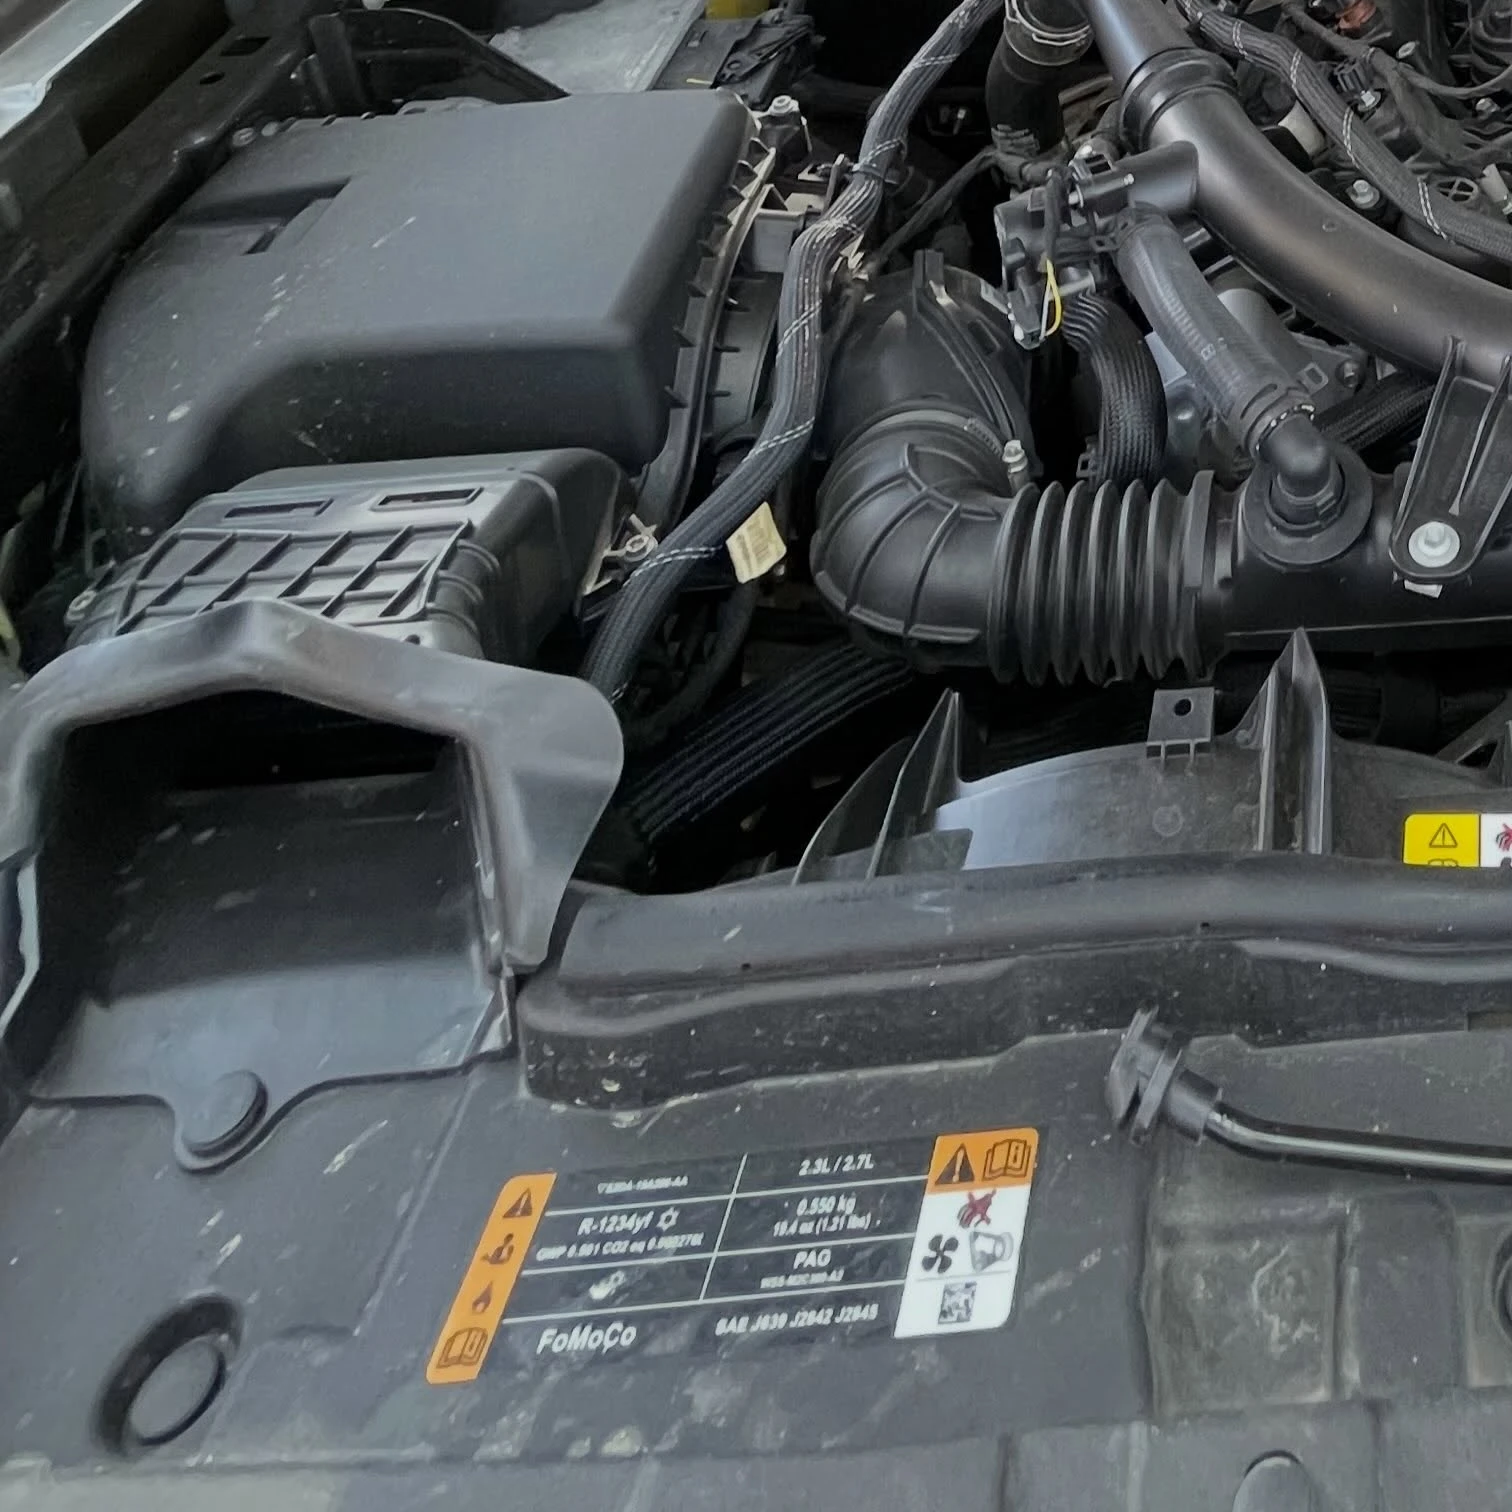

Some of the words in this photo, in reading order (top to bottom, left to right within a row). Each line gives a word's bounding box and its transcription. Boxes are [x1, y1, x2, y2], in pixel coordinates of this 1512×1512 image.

[842, 1153, 874, 1172] 2.7L
[796, 1197, 836, 1216] 0.550
[837, 1192, 857, 1215] kg
[577, 1211, 654, 1235] R-1234yf
[602, 1239, 630, 1255] CO2
[793, 1249, 831, 1270] PAG
[715, 1316, 749, 1336] SAE
[536, 1320, 637, 1355] FoMoCo
